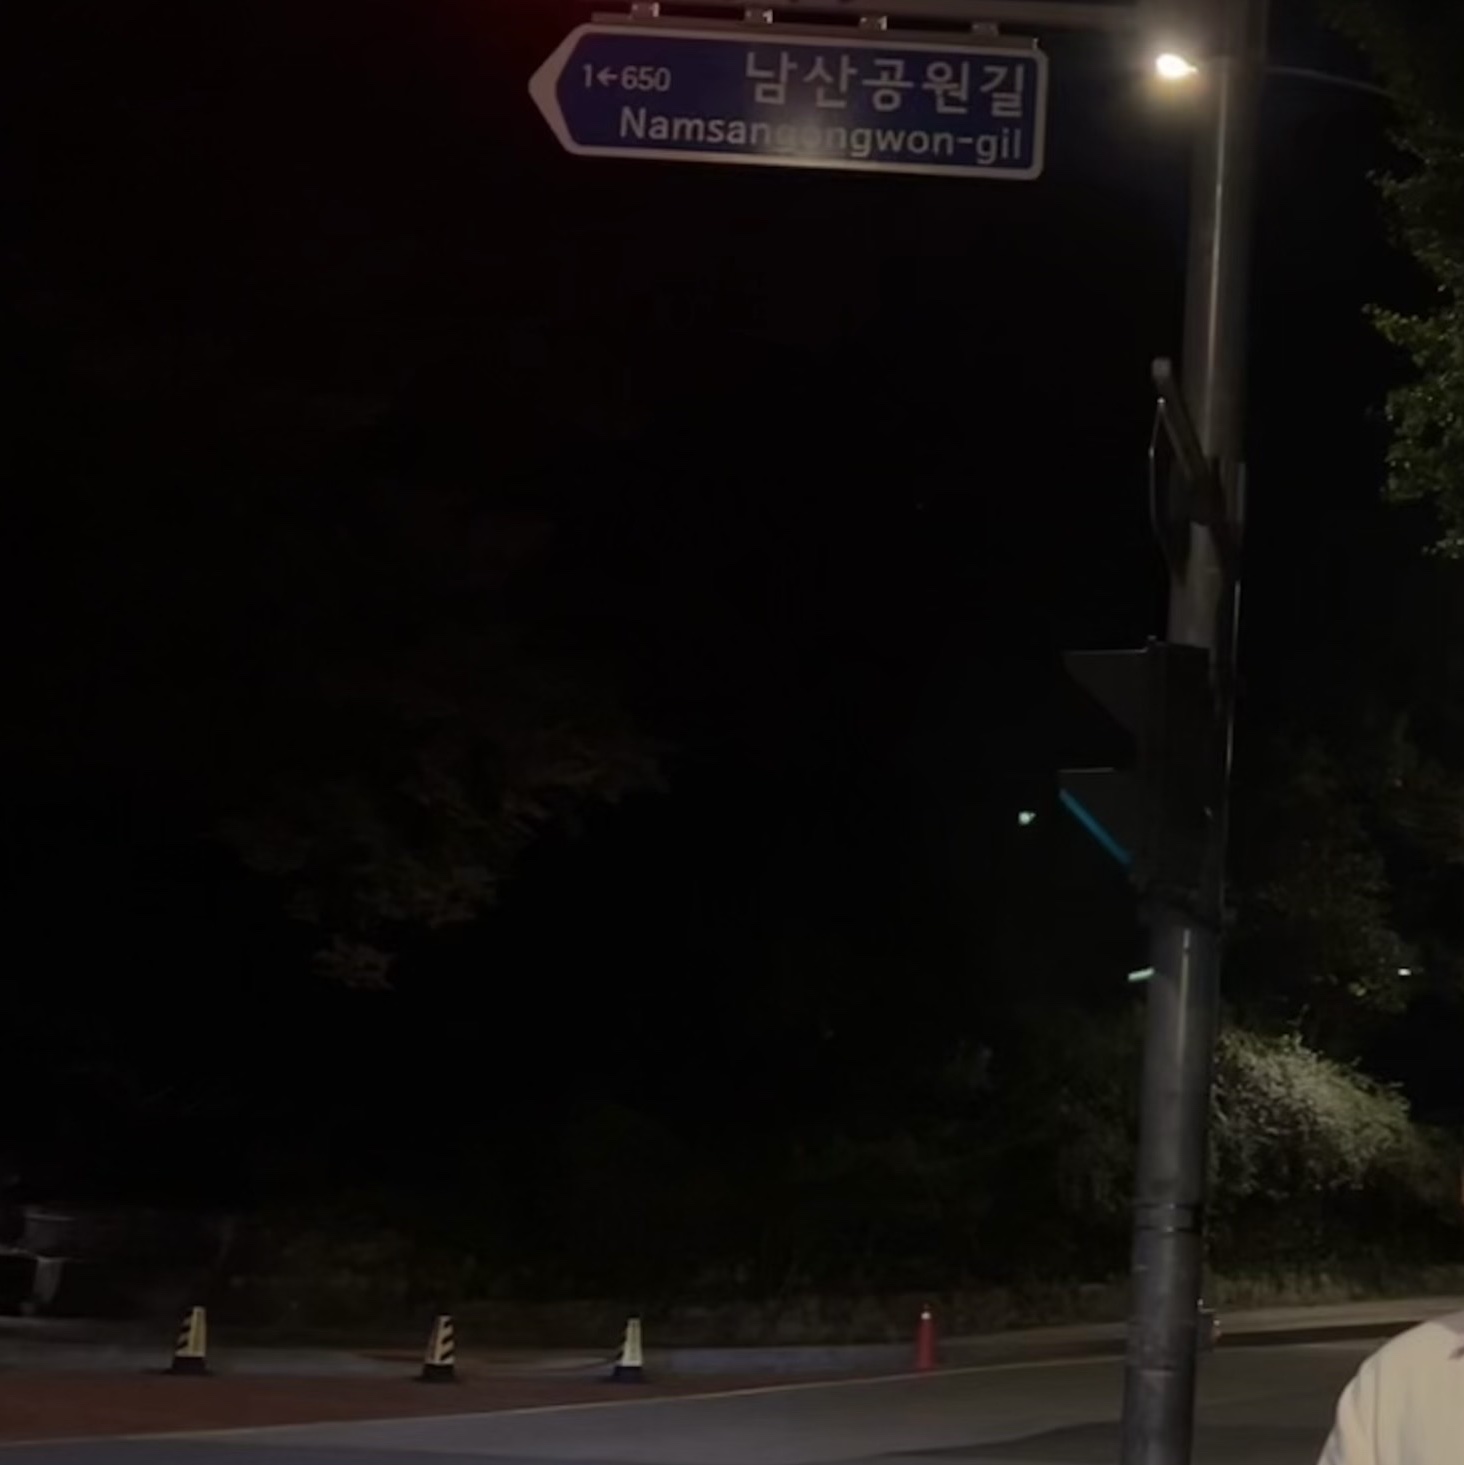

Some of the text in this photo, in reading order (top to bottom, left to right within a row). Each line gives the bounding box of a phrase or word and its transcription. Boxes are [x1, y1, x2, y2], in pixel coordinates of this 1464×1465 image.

[621, 66, 673, 92] 650
[744, 51, 1025, 118] 남산공원길
[619, 106, 1022, 164] Namsangongwon-gil
